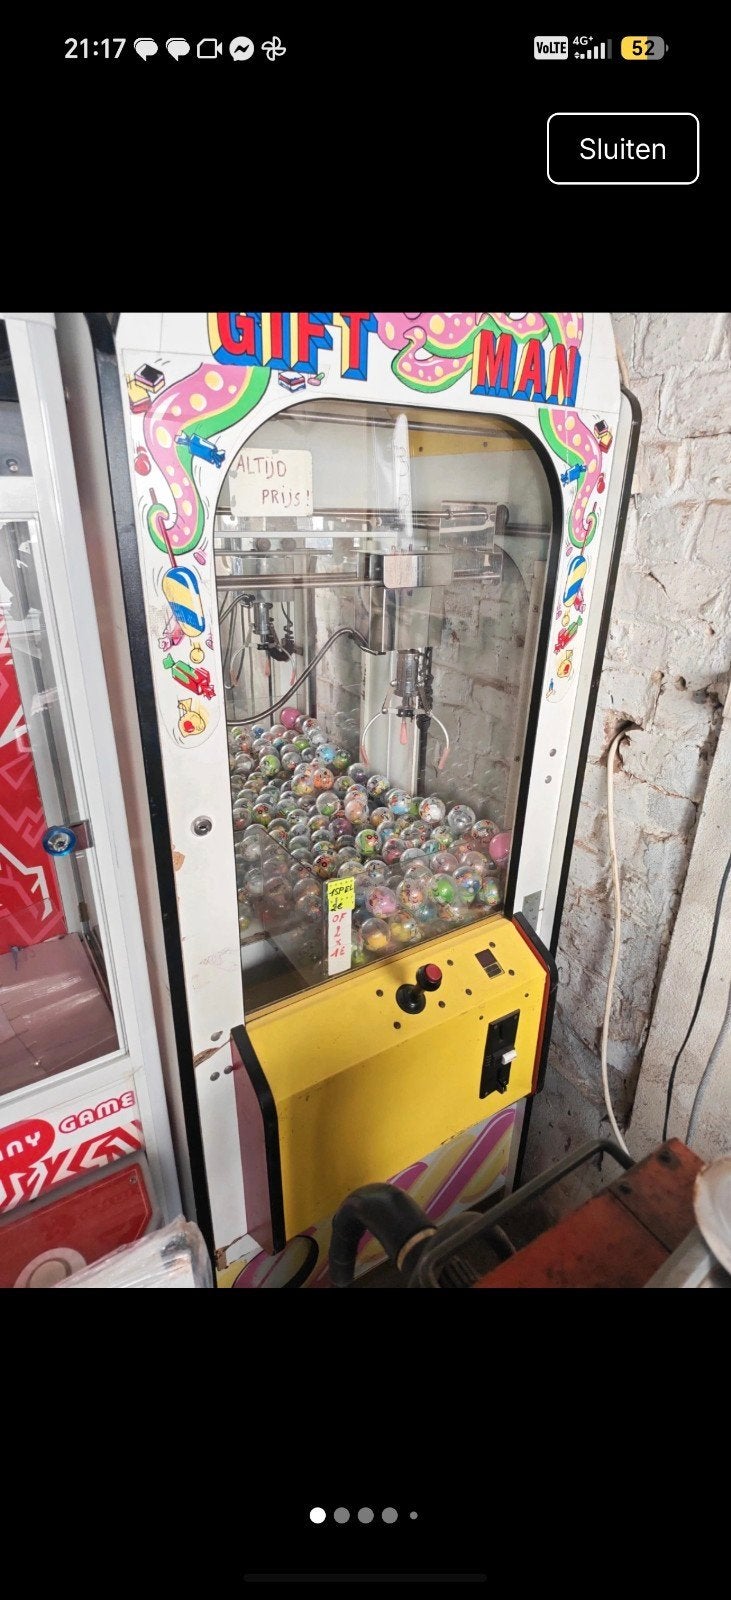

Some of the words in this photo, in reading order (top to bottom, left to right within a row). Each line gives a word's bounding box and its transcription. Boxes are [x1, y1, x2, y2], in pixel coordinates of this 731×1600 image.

[207, 312, 378, 381] GIFT
[470, 328, 582, 408] MAN
[332, 912, 347, 923] OF
[58, 1090, 136, 1134] GAME
